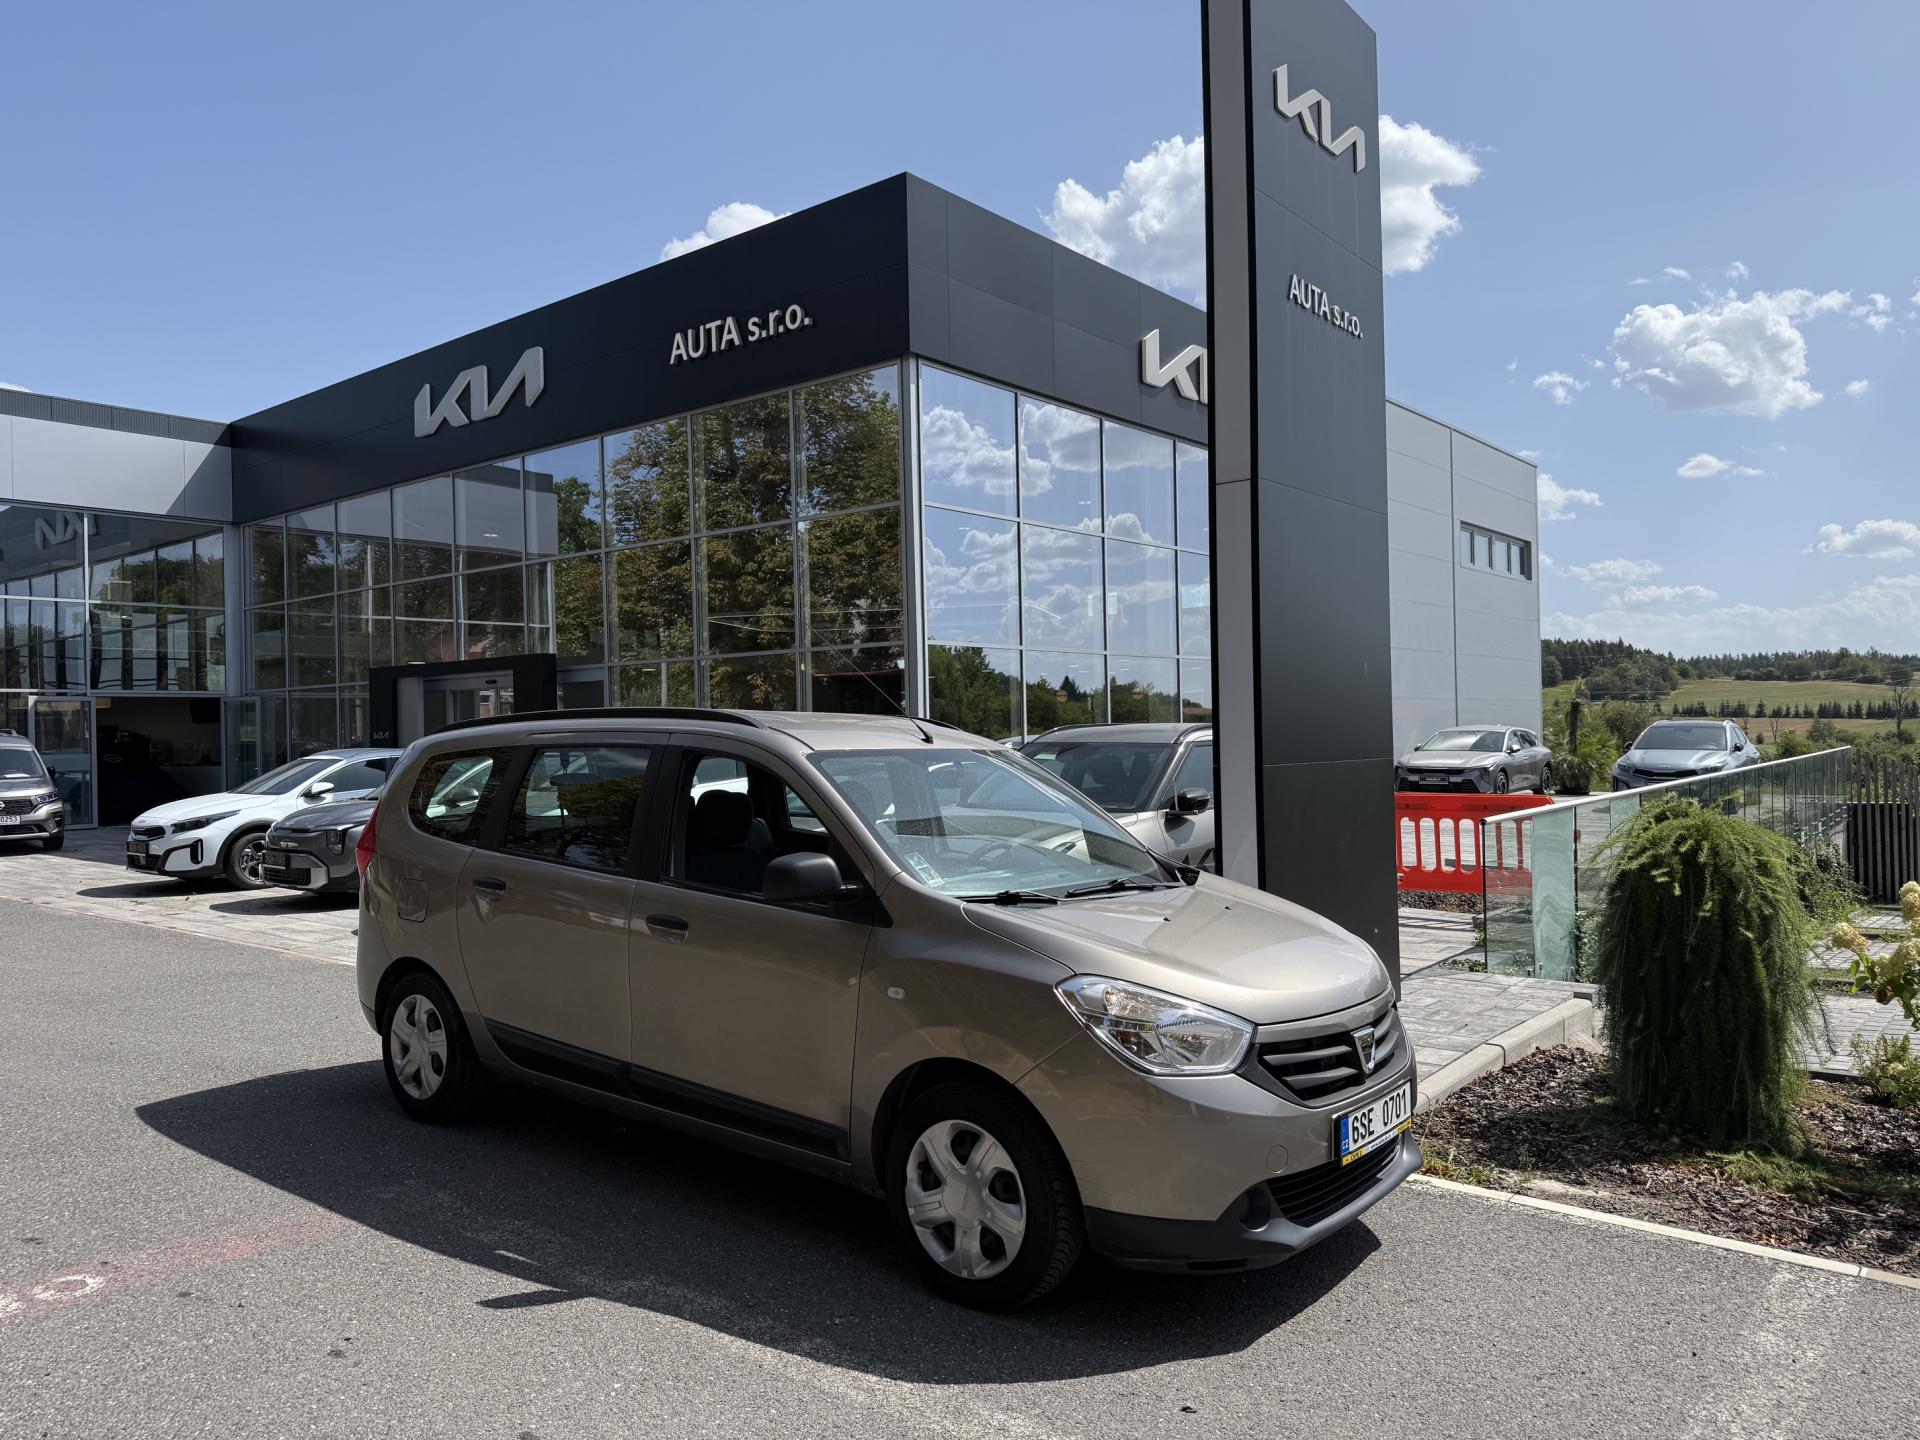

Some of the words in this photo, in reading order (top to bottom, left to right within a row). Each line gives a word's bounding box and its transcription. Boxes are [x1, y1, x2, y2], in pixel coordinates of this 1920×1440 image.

[1273, 63, 1366, 174] KIA
[669, 315, 743, 366] AUTA
[747, 303, 813, 342] s.r.o.
[1288, 273, 1331, 321] AUTA
[1330, 305, 1364, 339] s.r.o.
[413, 345, 545, 438] KIA
[1341, 1139, 1349, 1150] CZ
[1351, 1106, 1375, 1145] 6SE
[1382, 1087, 1407, 1128] 0701
